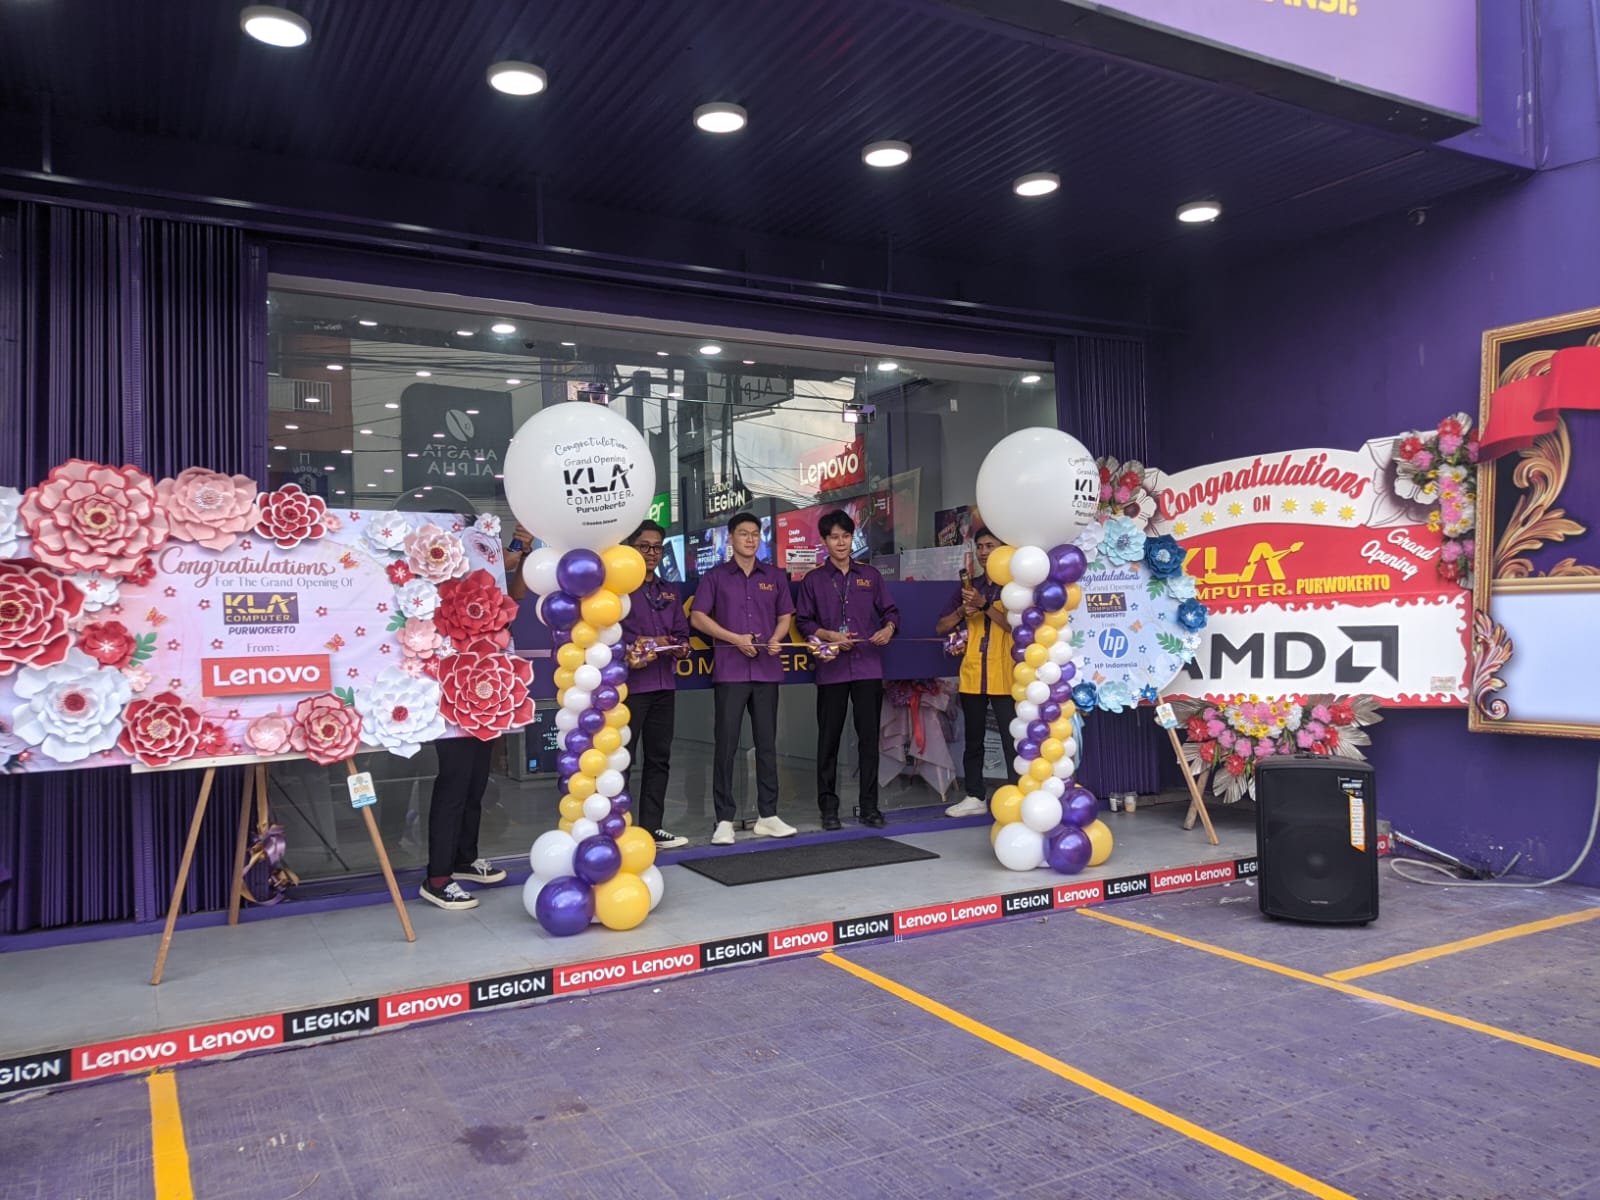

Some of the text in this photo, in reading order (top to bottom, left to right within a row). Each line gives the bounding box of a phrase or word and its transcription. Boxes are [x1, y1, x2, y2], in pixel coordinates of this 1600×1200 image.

[564, 455, 626, 467] Grand Opening
[800, 453, 859, 486] Lenovo
[563, 463, 634, 496] KLA
[1074, 478, 1099, 501] KL
[1159, 453, 1371, 521] Congratulations
[576, 501, 626, 514] Purwokerto
[708, 489, 746, 513] LEGION
[1253, 495, 1271, 513] ON
[1387, 528, 1440, 560] Grand
[159, 545, 336, 588] Congratulations
[1361, 540, 1418, 581] Opening
[215, 577, 354, 589] For The Grand Opening Of
[1080, 570, 1140, 586] ngratulations
[1296, 575, 1390, 595] PURWOKERTO
[225, 594, 297, 614] KLA
[1087, 593, 1124, 607] KLA
[228, 625, 296, 636] PURWOKERTO
[1103, 628, 1125, 659] hp
[213, 665, 320, 687] Lenovo
[0, 861, 1258, 1085] GION Lenovo Lenovo LEGION Lenovo LEGION Lenovo Lenovo LEGION Lenovo LEGION Lenovo Lenovo LEGION Lenovo LEGION Lenovo Lenovo LEGI
